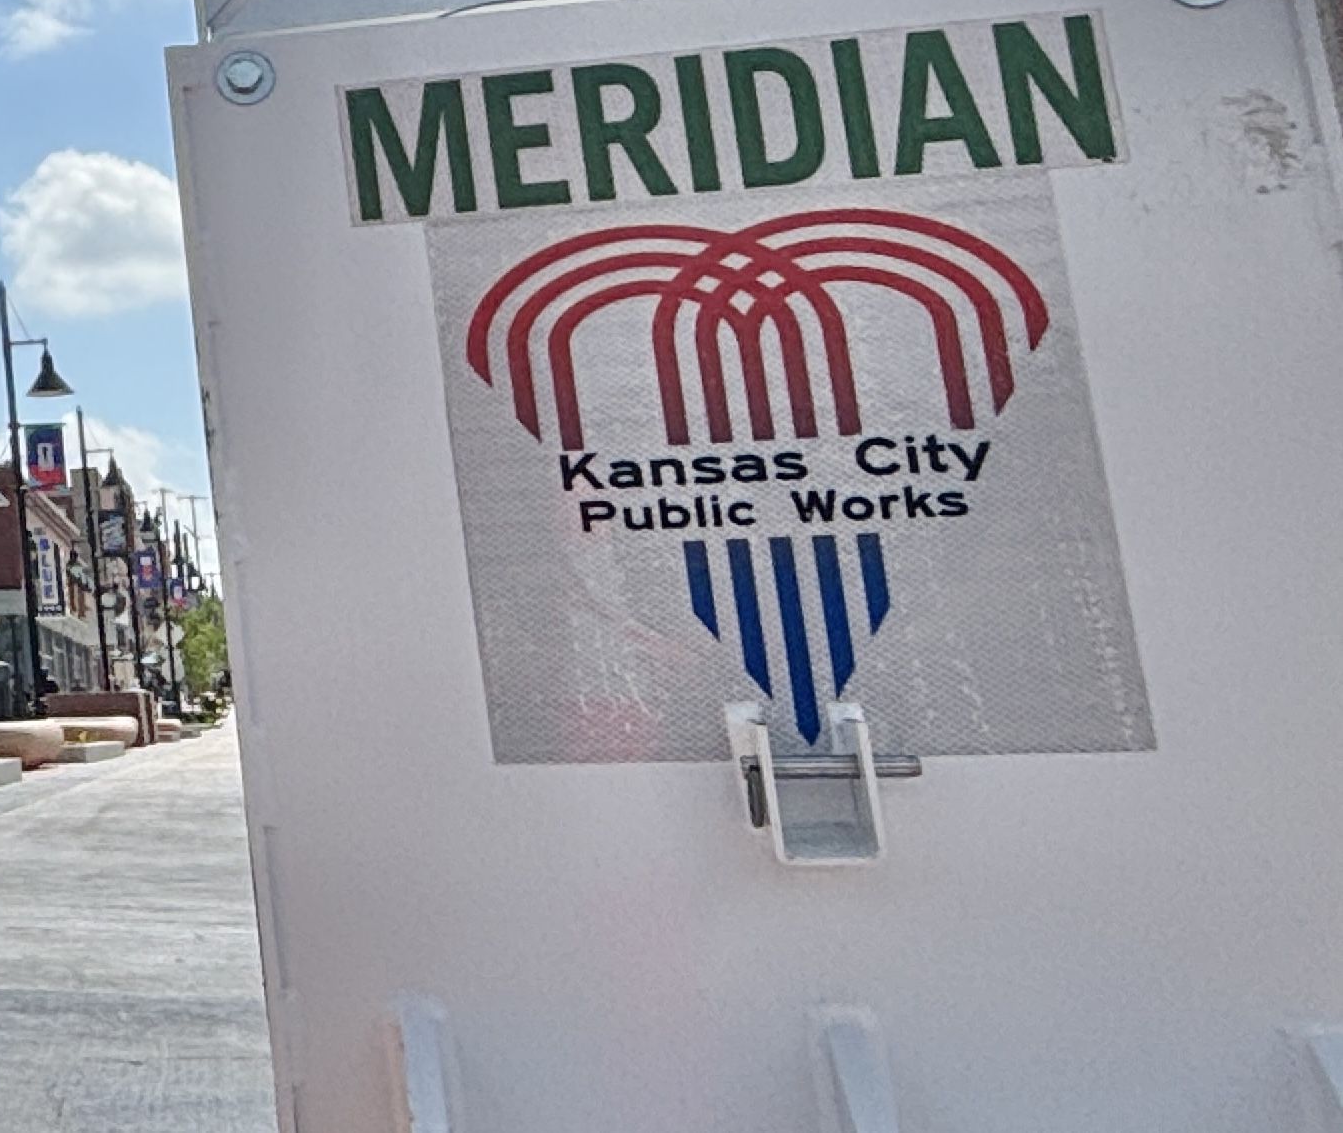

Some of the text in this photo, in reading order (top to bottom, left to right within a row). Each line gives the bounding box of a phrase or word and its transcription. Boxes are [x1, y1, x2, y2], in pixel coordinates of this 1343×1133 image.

[344, 15, 1116, 221] MERIDIAN
[560, 436, 991, 491] Kansas City
[580, 485, 970, 532] Public Works
